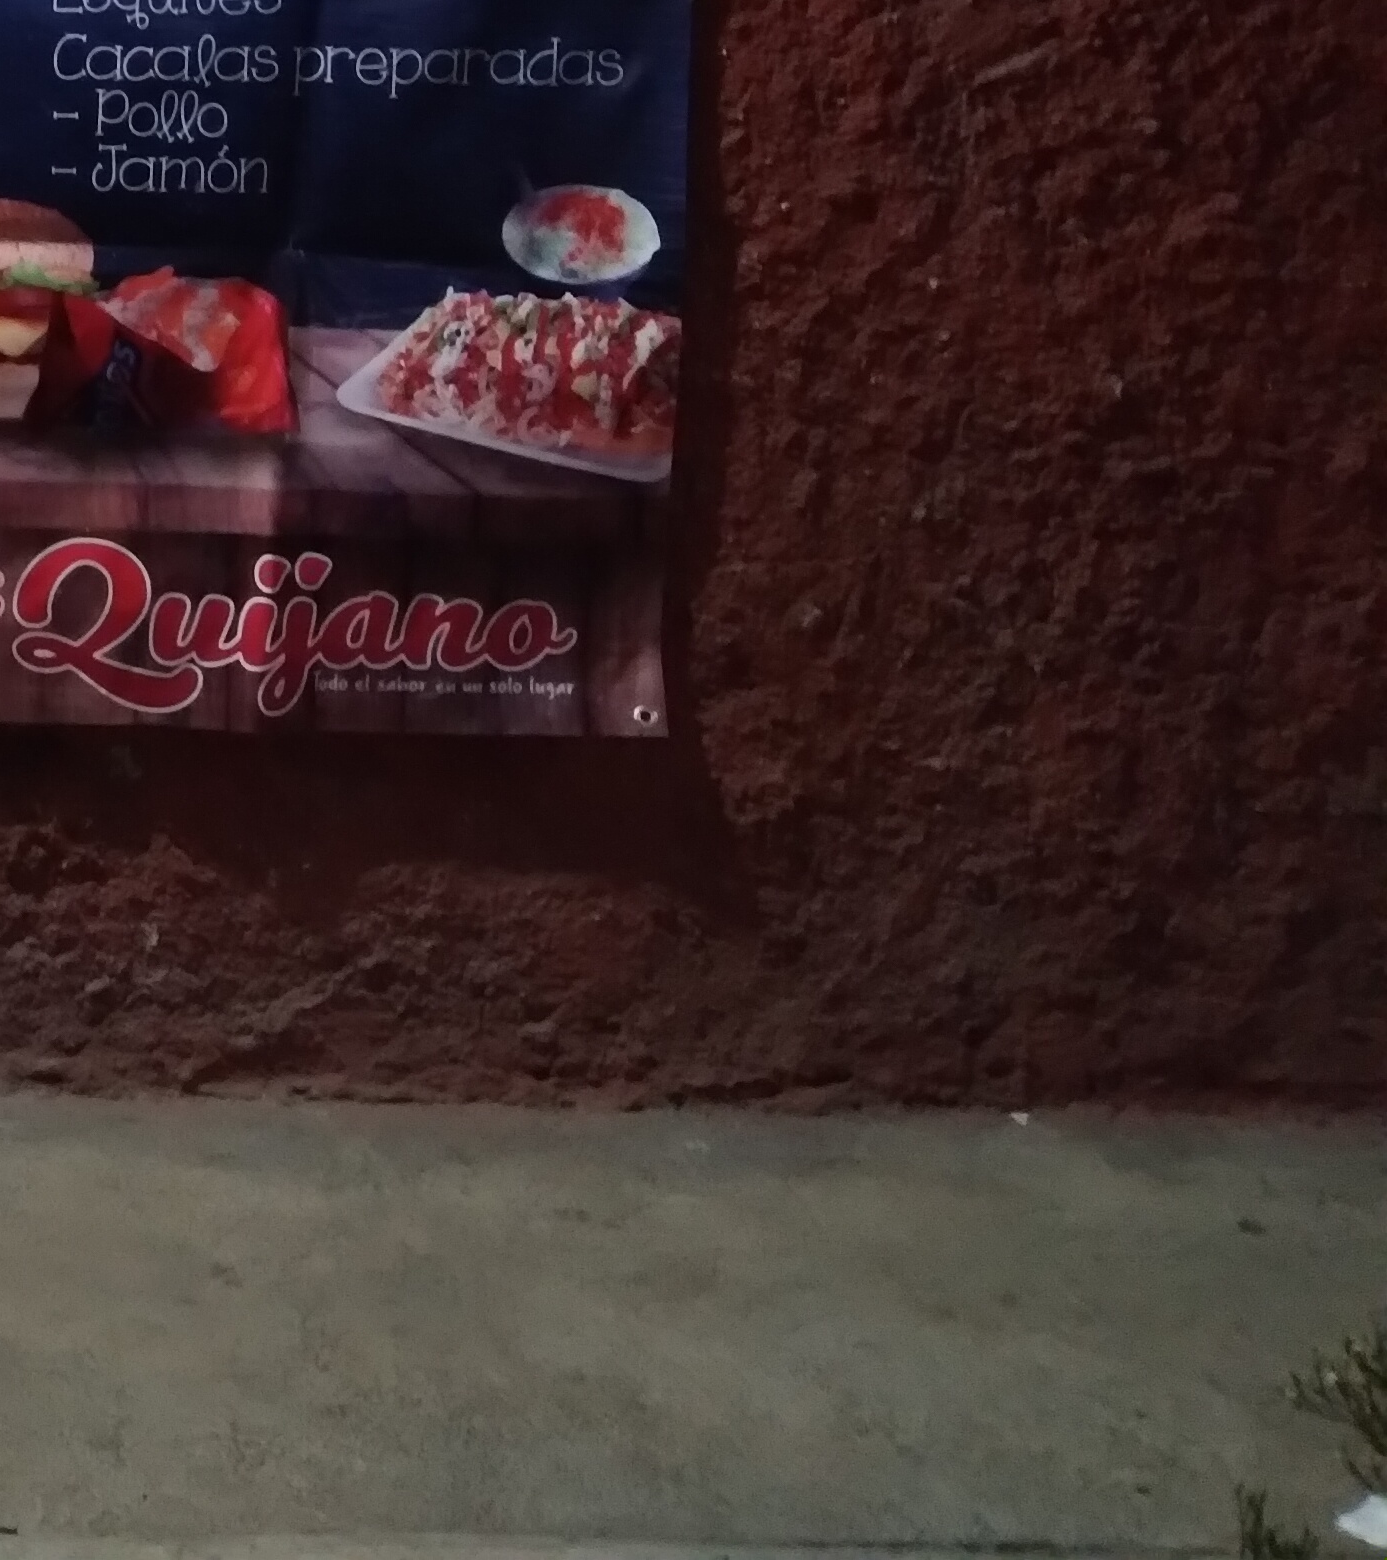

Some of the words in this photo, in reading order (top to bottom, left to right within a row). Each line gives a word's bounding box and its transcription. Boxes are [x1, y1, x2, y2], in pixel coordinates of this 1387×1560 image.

[53, 33, 279, 87] Cacalas
[293, 37, 624, 98] preparadas
[94, 88, 229, 143] Pollo
[91, 144, 269, 194] Jamón
[12, 536, 577, 717] Quijano
[489, 676, 523, 694] solo
[529, 675, 574, 700] lugar
